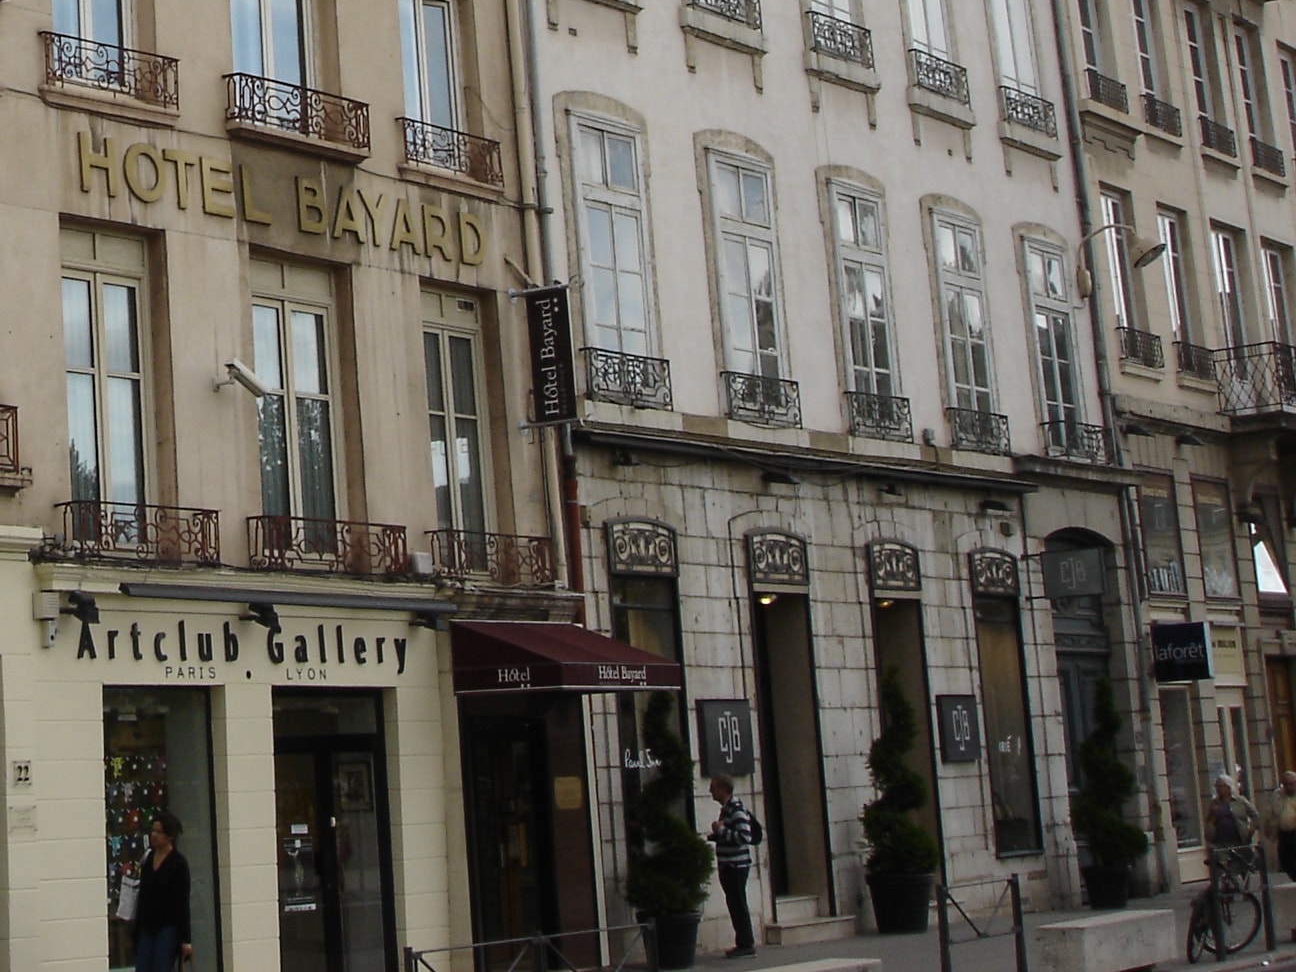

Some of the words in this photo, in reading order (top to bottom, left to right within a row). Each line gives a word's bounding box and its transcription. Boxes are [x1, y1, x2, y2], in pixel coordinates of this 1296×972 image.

[77, 131, 272, 225] HOTEL
[294, 176, 487, 266] BAYARD
[535, 298, 557, 360] Bayard
[541, 366, 559, 415] Hôtel
[77, 619, 239, 662] Artclub
[267, 624, 407, 675] Gallery
[1155, 642, 1204, 661] laforêt
[165, 666, 216, 679] PARIS
[286, 668, 327, 680] LYON
[498, 667, 530, 682] Hôtel
[598, 665, 620, 680] Hôtel
[622, 665, 646, 683] Bayard
[17, 765, 29, 781] 22
